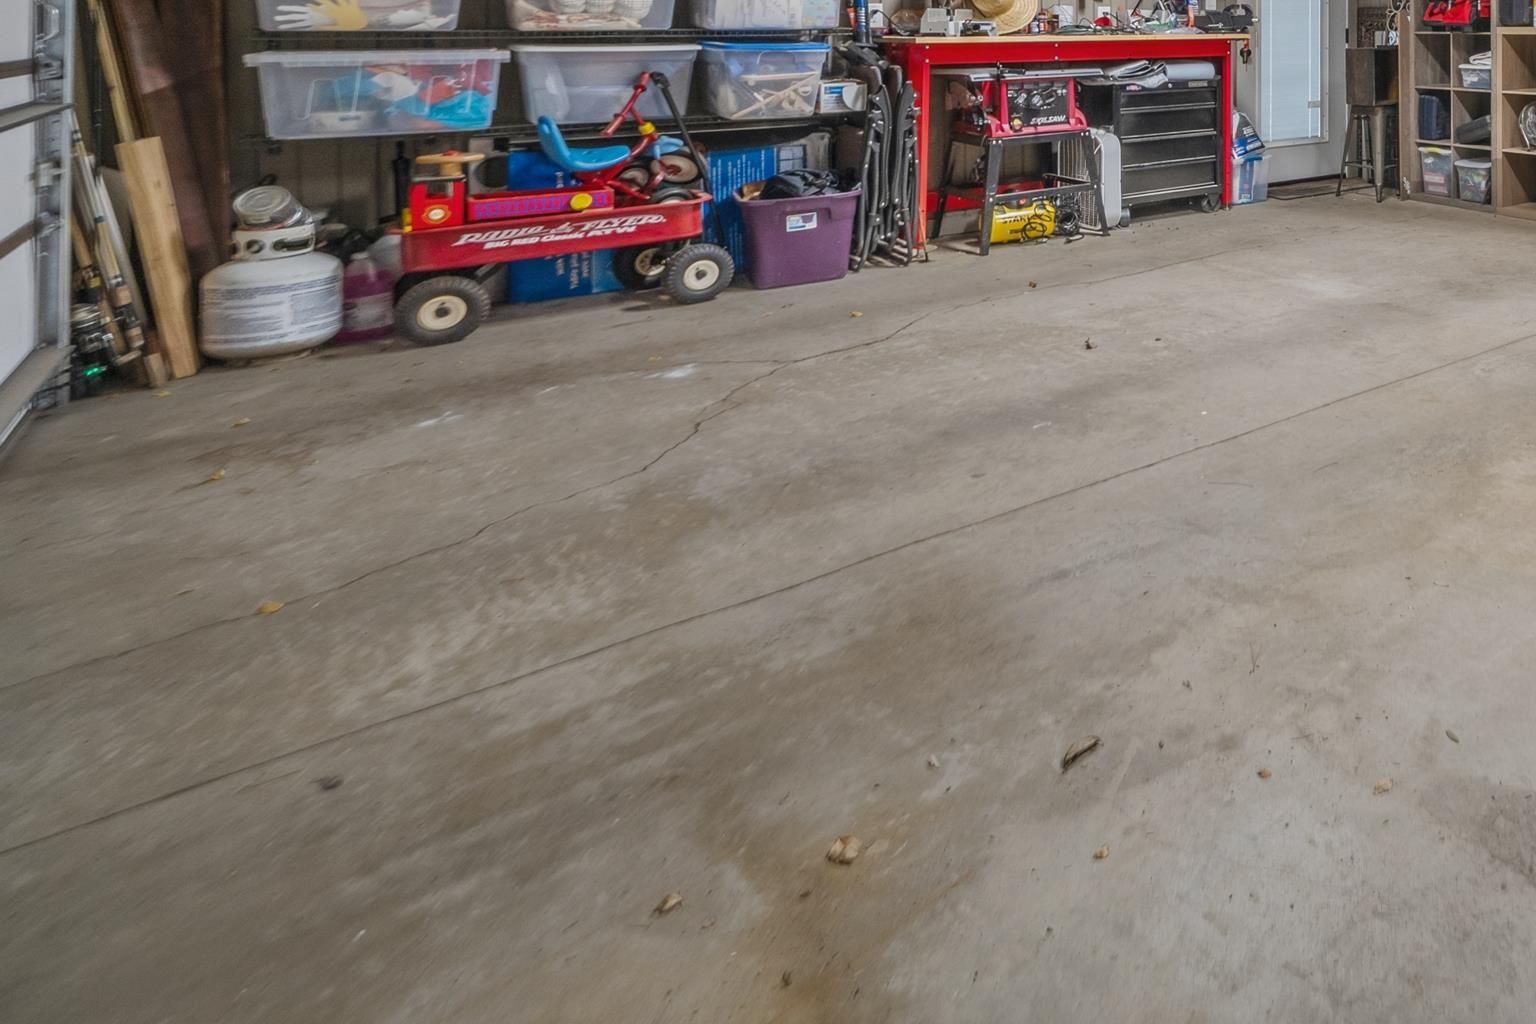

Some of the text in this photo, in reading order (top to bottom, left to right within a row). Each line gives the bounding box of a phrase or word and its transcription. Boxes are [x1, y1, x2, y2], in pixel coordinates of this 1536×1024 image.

[1030, 115, 1066, 125] SKILSAW
[451, 225, 545, 246] RADIO
[511, 235, 539, 246] RED
